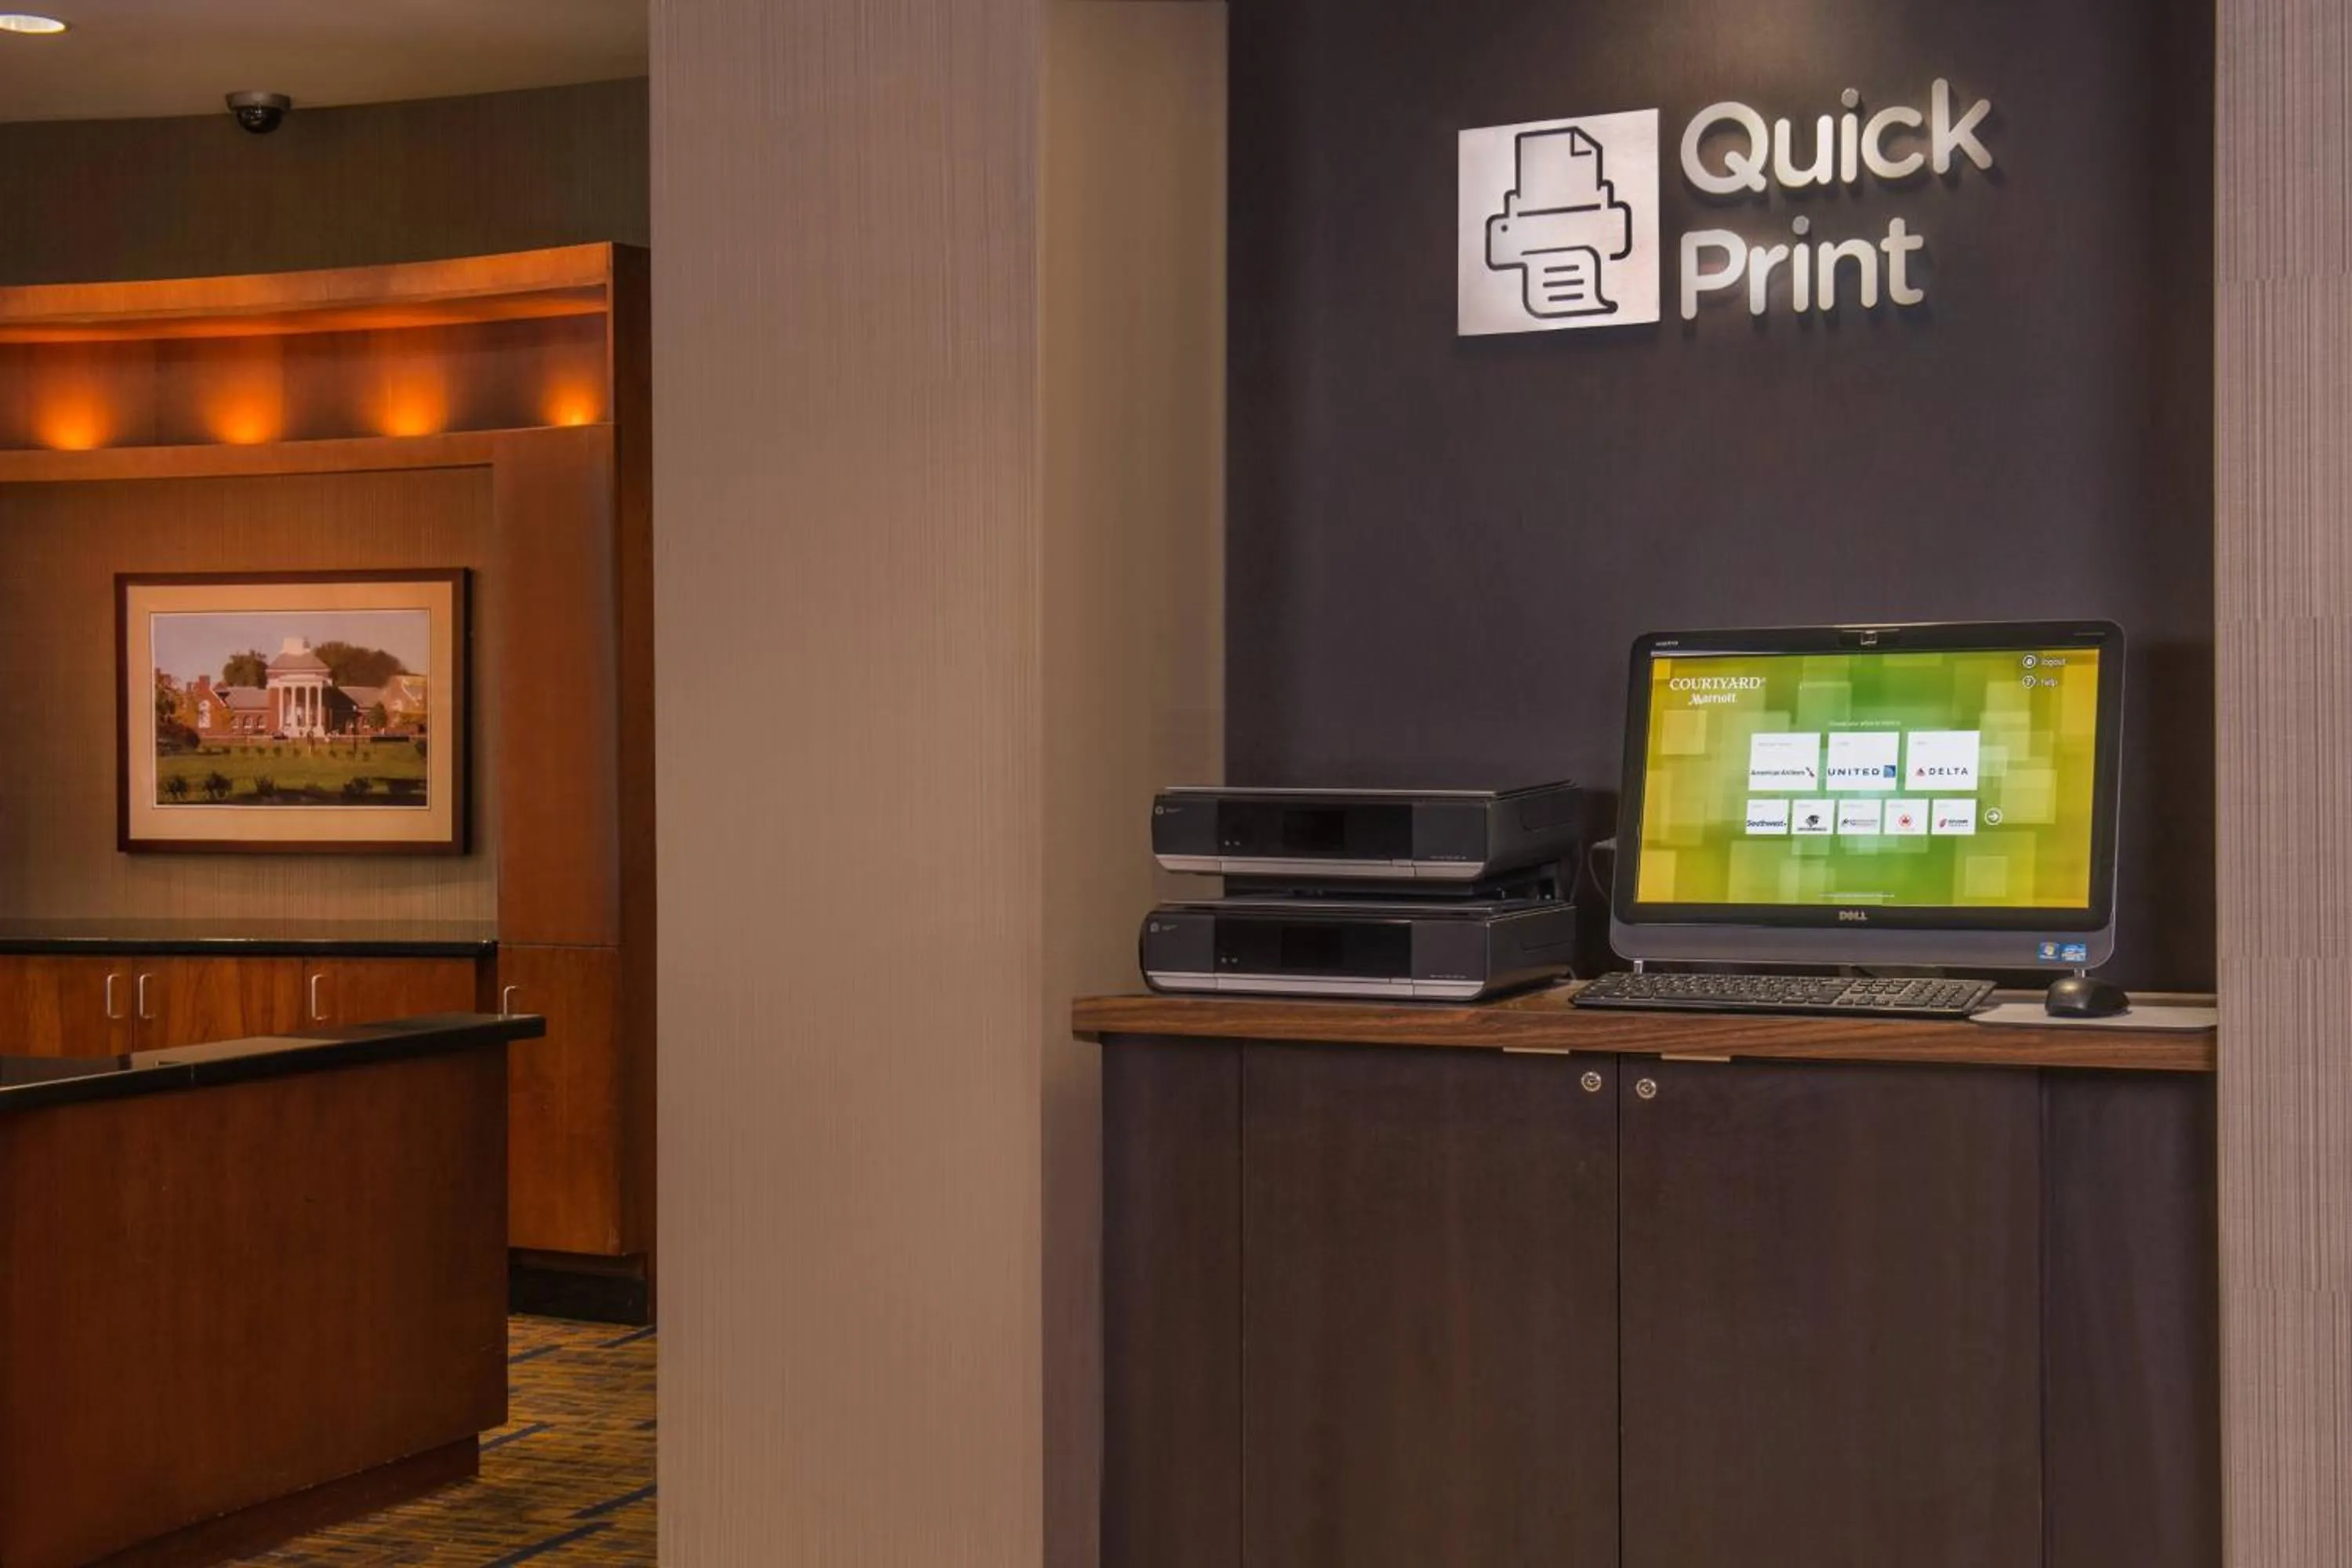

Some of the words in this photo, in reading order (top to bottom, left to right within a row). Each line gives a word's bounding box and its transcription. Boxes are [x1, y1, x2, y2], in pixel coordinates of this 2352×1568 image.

[1680, 77, 1994, 194] Quick
[1680, 216, 1926, 321] Print
[1669, 677, 1762, 691] COURTYARD
[1688, 693, 1737, 706] Marriott
[1828, 768, 1881, 777] UNITED
[1929, 767, 1969, 776] DELTA
[1838, 910, 1868, 921] DELL
